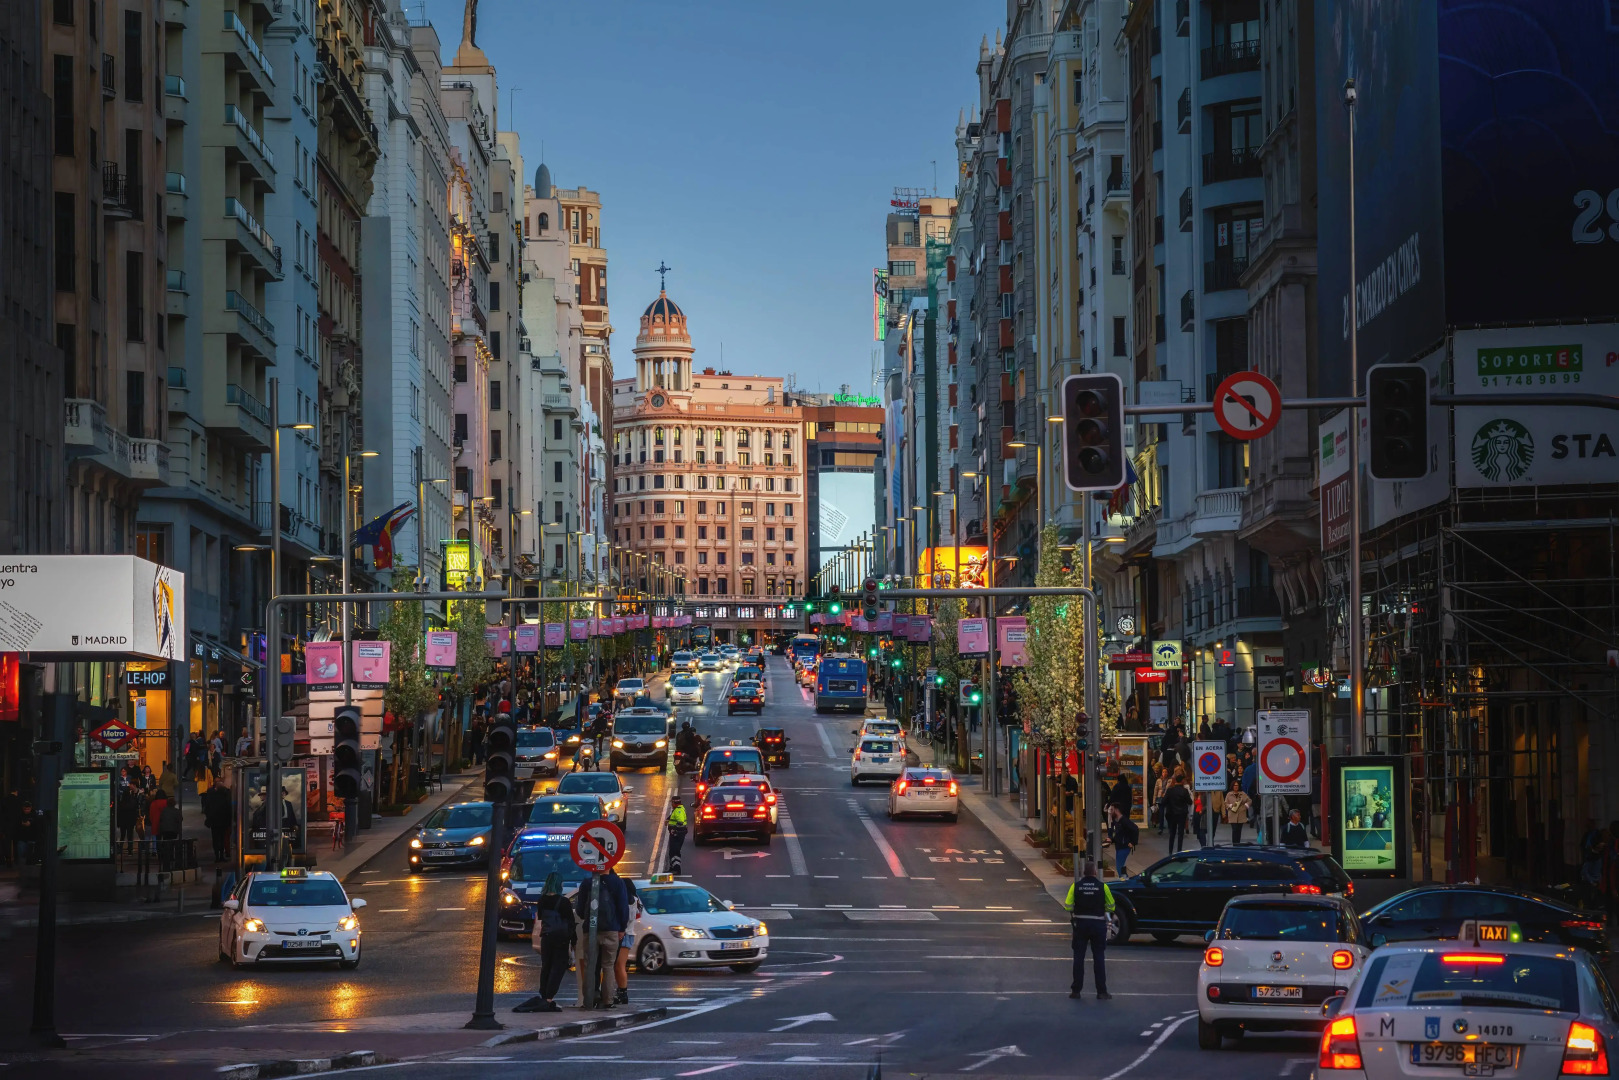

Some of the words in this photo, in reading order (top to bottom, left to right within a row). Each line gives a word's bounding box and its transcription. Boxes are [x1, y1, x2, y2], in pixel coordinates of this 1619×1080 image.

[1362, 262, 1386, 327] MARZO
[1387, 251, 1397, 305] EN
[1398, 231, 1420, 295] CINES
[1480, 351, 1580, 369] SOPORTES
[1482, 376, 1498, 387] 91
[1505, 375, 1533, 386] 748
[1539, 374, 1556, 385] 98
[1563, 373, 1580, 384] 99
[1551, 433, 1617, 460] STA
[85, 636, 127, 645] MADRID
[127, 672, 166, 685] LE-HOP
[103, 730, 126, 739] Metro
[1481, 925, 1508, 940] TAXI
[1258, 986, 1280, 997] 5725
[1283, 986, 1301, 997] JMR
[1380, 1018, 1395, 1037] M
[1478, 1025, 1513, 1036] 14070
[1425, 1045, 1465, 1061] 9796
[1474, 1045, 1506, 1062] HFC
